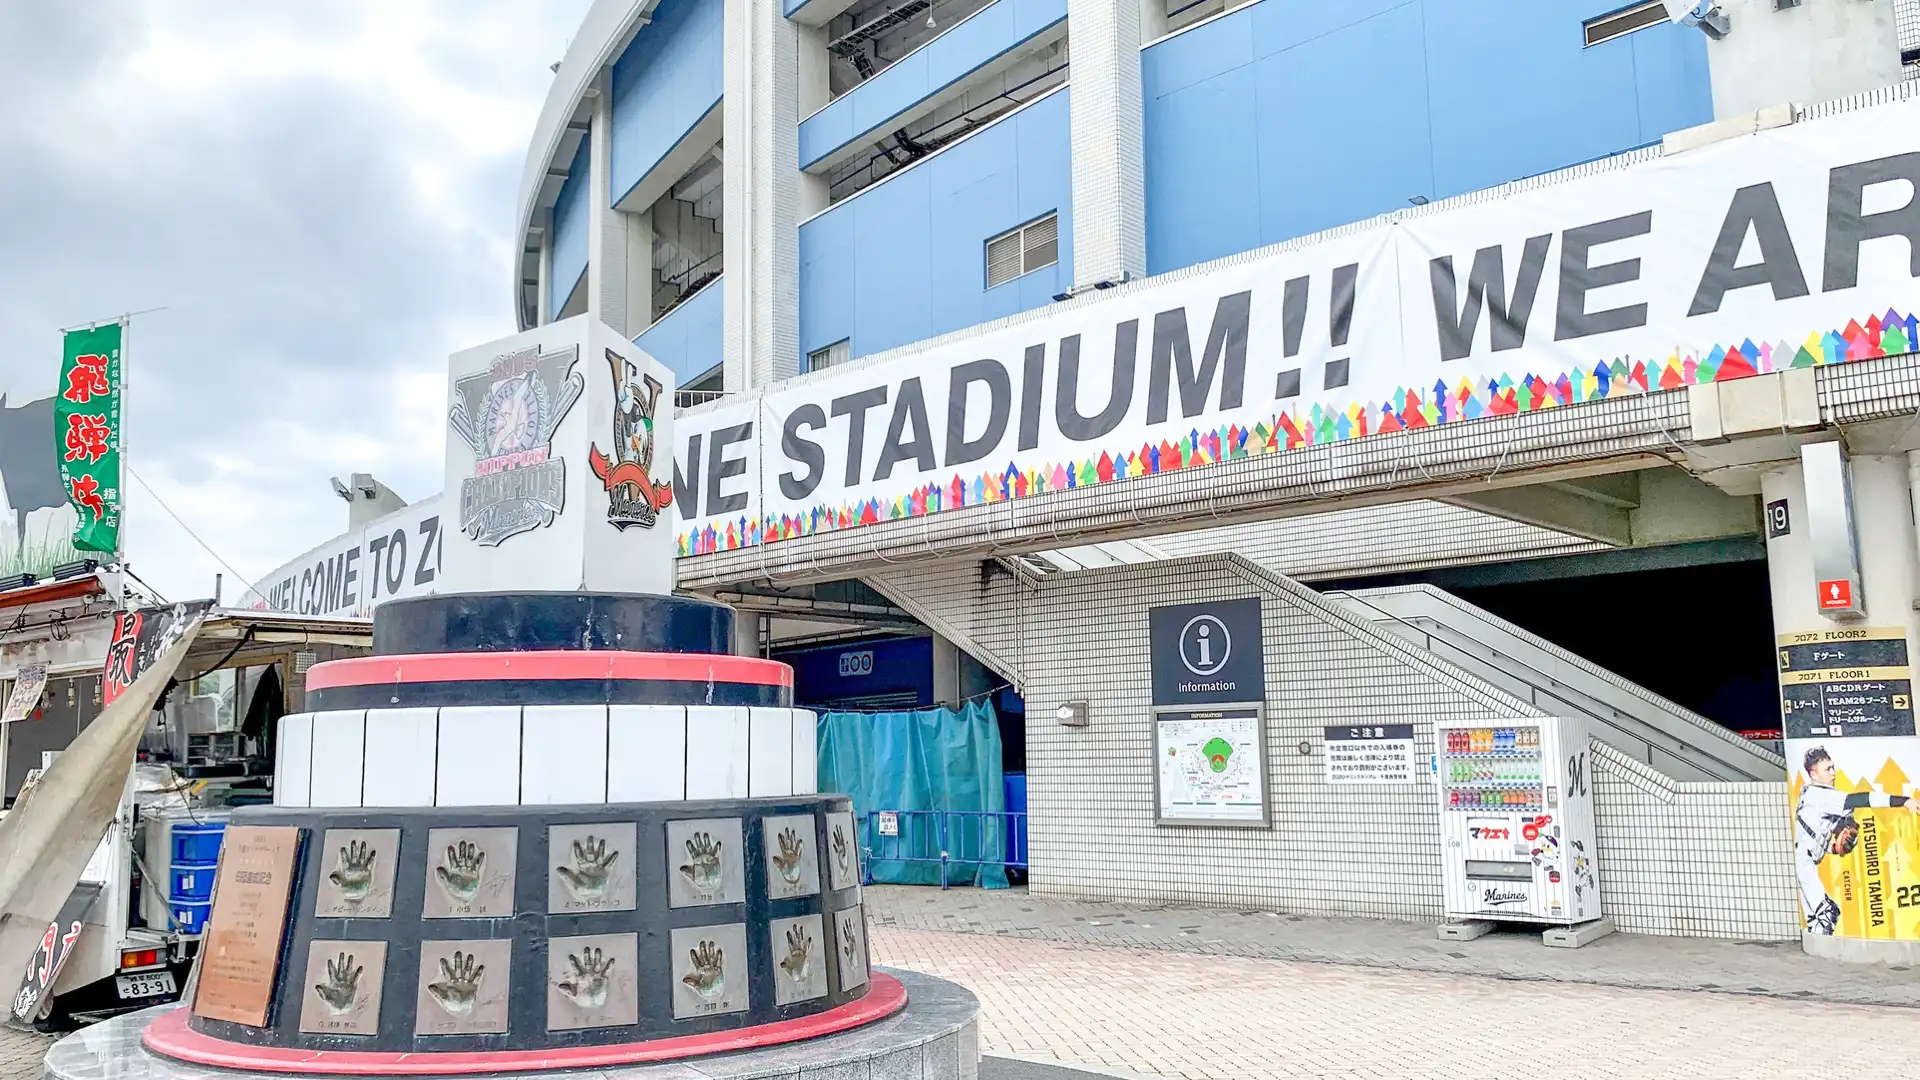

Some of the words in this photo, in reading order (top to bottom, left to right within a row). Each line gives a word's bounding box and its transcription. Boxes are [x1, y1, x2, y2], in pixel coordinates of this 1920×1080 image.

[1429, 210, 1653, 361] WE
[63, 353, 111, 526] 飛騨牛
[1768, 505, 1788, 533] 19
[369, 528, 408, 600] TO
[414, 515, 444, 587] Z
[1825, 630, 1867, 640] FLOOR2
[106, 611, 137, 707] 最
[1813, 651, 1846, 661] Fゲート
[1829, 670, 1870, 679] FLOOR1
[1178, 680, 1237, 693] Information
[1825, 683, 1886, 693] ABCDRゲート
[1826, 696, 1889, 706] TEAM26ブース
[1828, 708, 1863, 716] マリーンズ
[1828, 715, 1882, 724] ドリームサルーン
[1350, 727, 1385, 738] ご注意
[1567, 751, 1587, 798] M
[1862, 815, 1881, 876] TATSUHIRO
[1842, 870, 1852, 901] CATCHER
[1483, 888, 1528, 902] Marines
[1868, 880, 1885, 927] TAMURA
[1896, 884, 1920, 908] 22
[131, 979, 172, 996] 83-91
